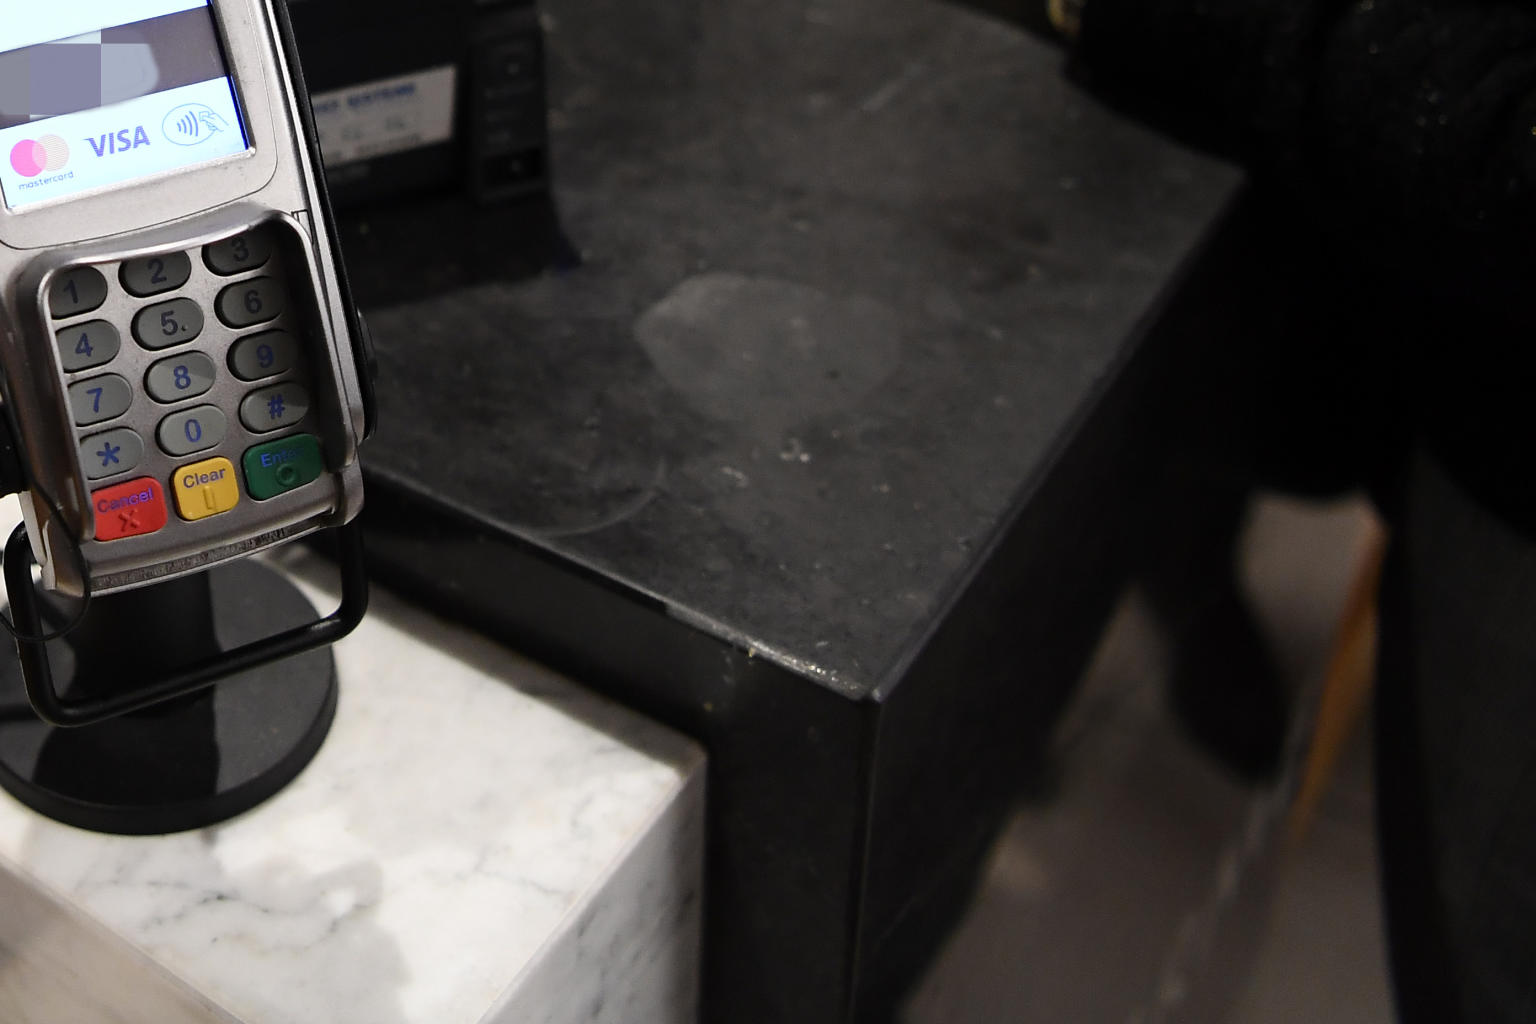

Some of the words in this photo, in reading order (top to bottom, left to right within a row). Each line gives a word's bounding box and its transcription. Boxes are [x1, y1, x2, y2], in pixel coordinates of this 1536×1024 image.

[84, 126, 150, 157] VISA
[18, 171, 74, 190] mastercard
[232, 238, 249, 262] 3
[148, 258, 167, 284] 2
[64, 280, 79, 304] 1
[244, 289, 262, 314] 6
[75, 332, 93, 357] 4
[255, 344, 274, 368] 9
[173, 365, 191, 390] 8
[86, 387, 103, 413] 7
[183, 467, 226, 489] Clear
[97, 488, 153, 513] Cancel
